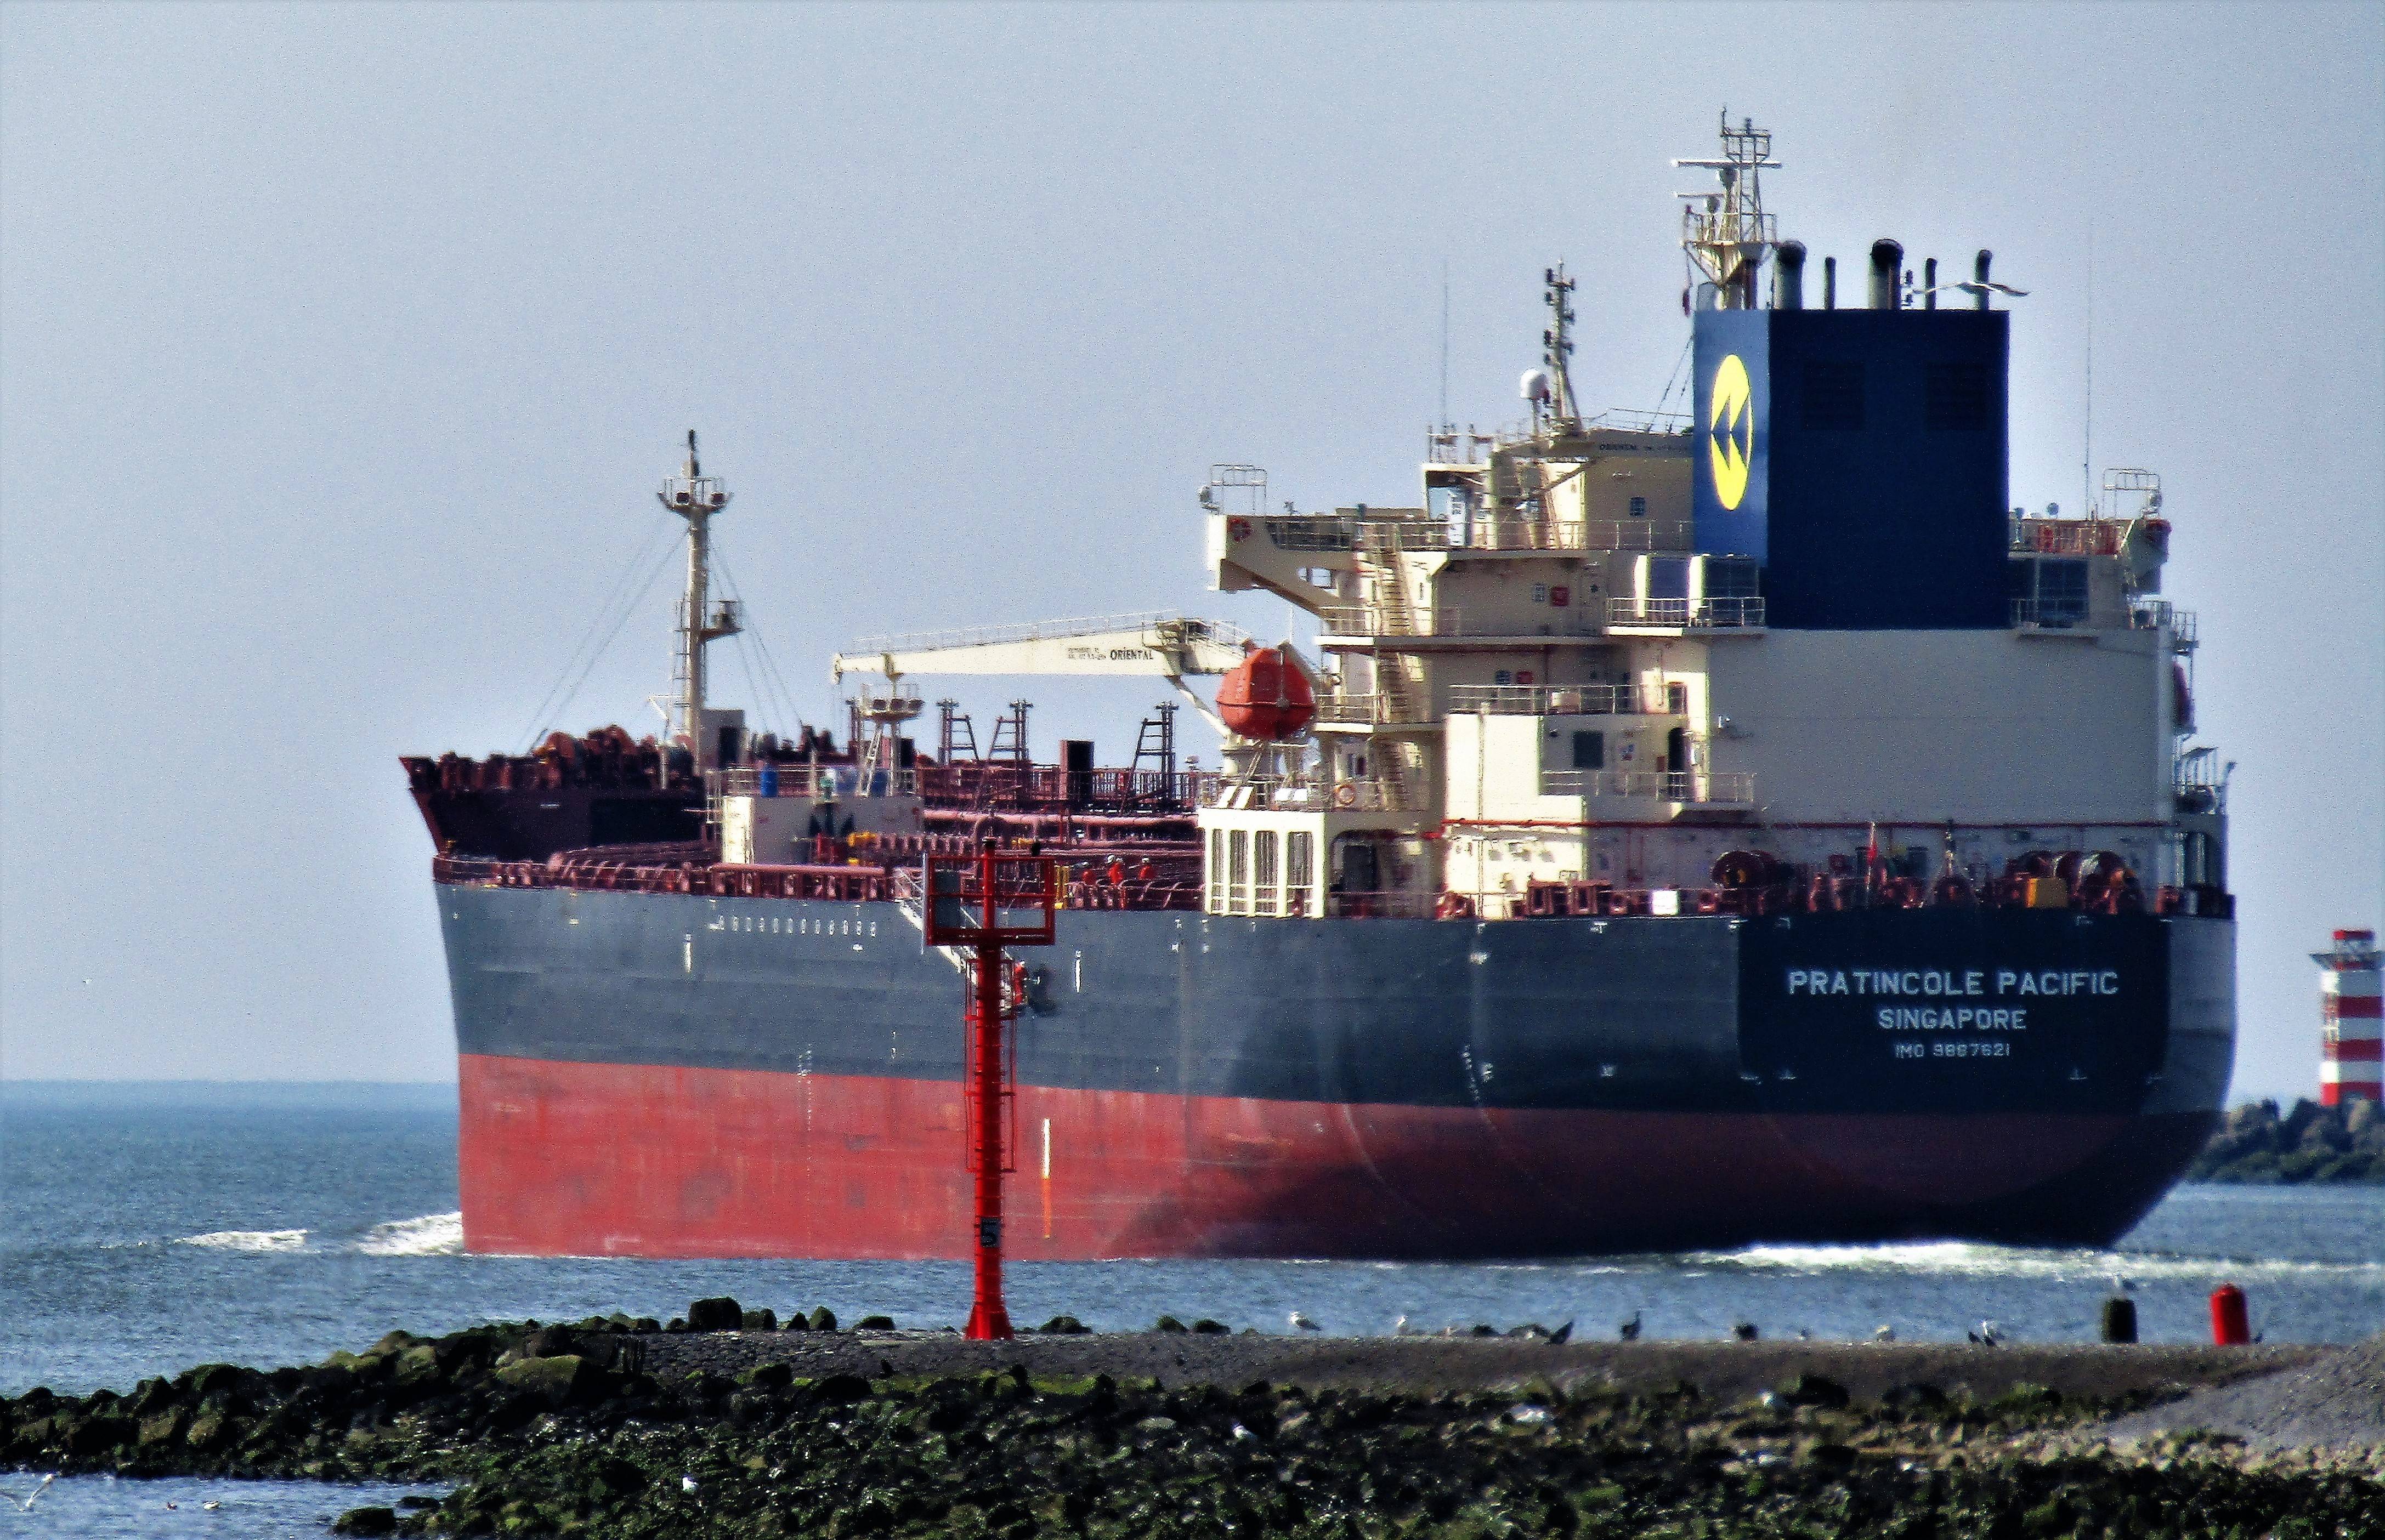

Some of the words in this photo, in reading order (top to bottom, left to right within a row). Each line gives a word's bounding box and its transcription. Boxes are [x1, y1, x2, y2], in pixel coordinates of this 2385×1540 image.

[1110, 648, 1154, 661] ORIENTAL
[1788, 971, 1984, 995] PRATINCOLE
[1998, 971, 2118, 995] PACIFIC
[1878, 1008, 2027, 1030] SINGAPORE
[1895, 1043, 1925, 1058] IMO
[982, 1222, 997, 1246] 5
